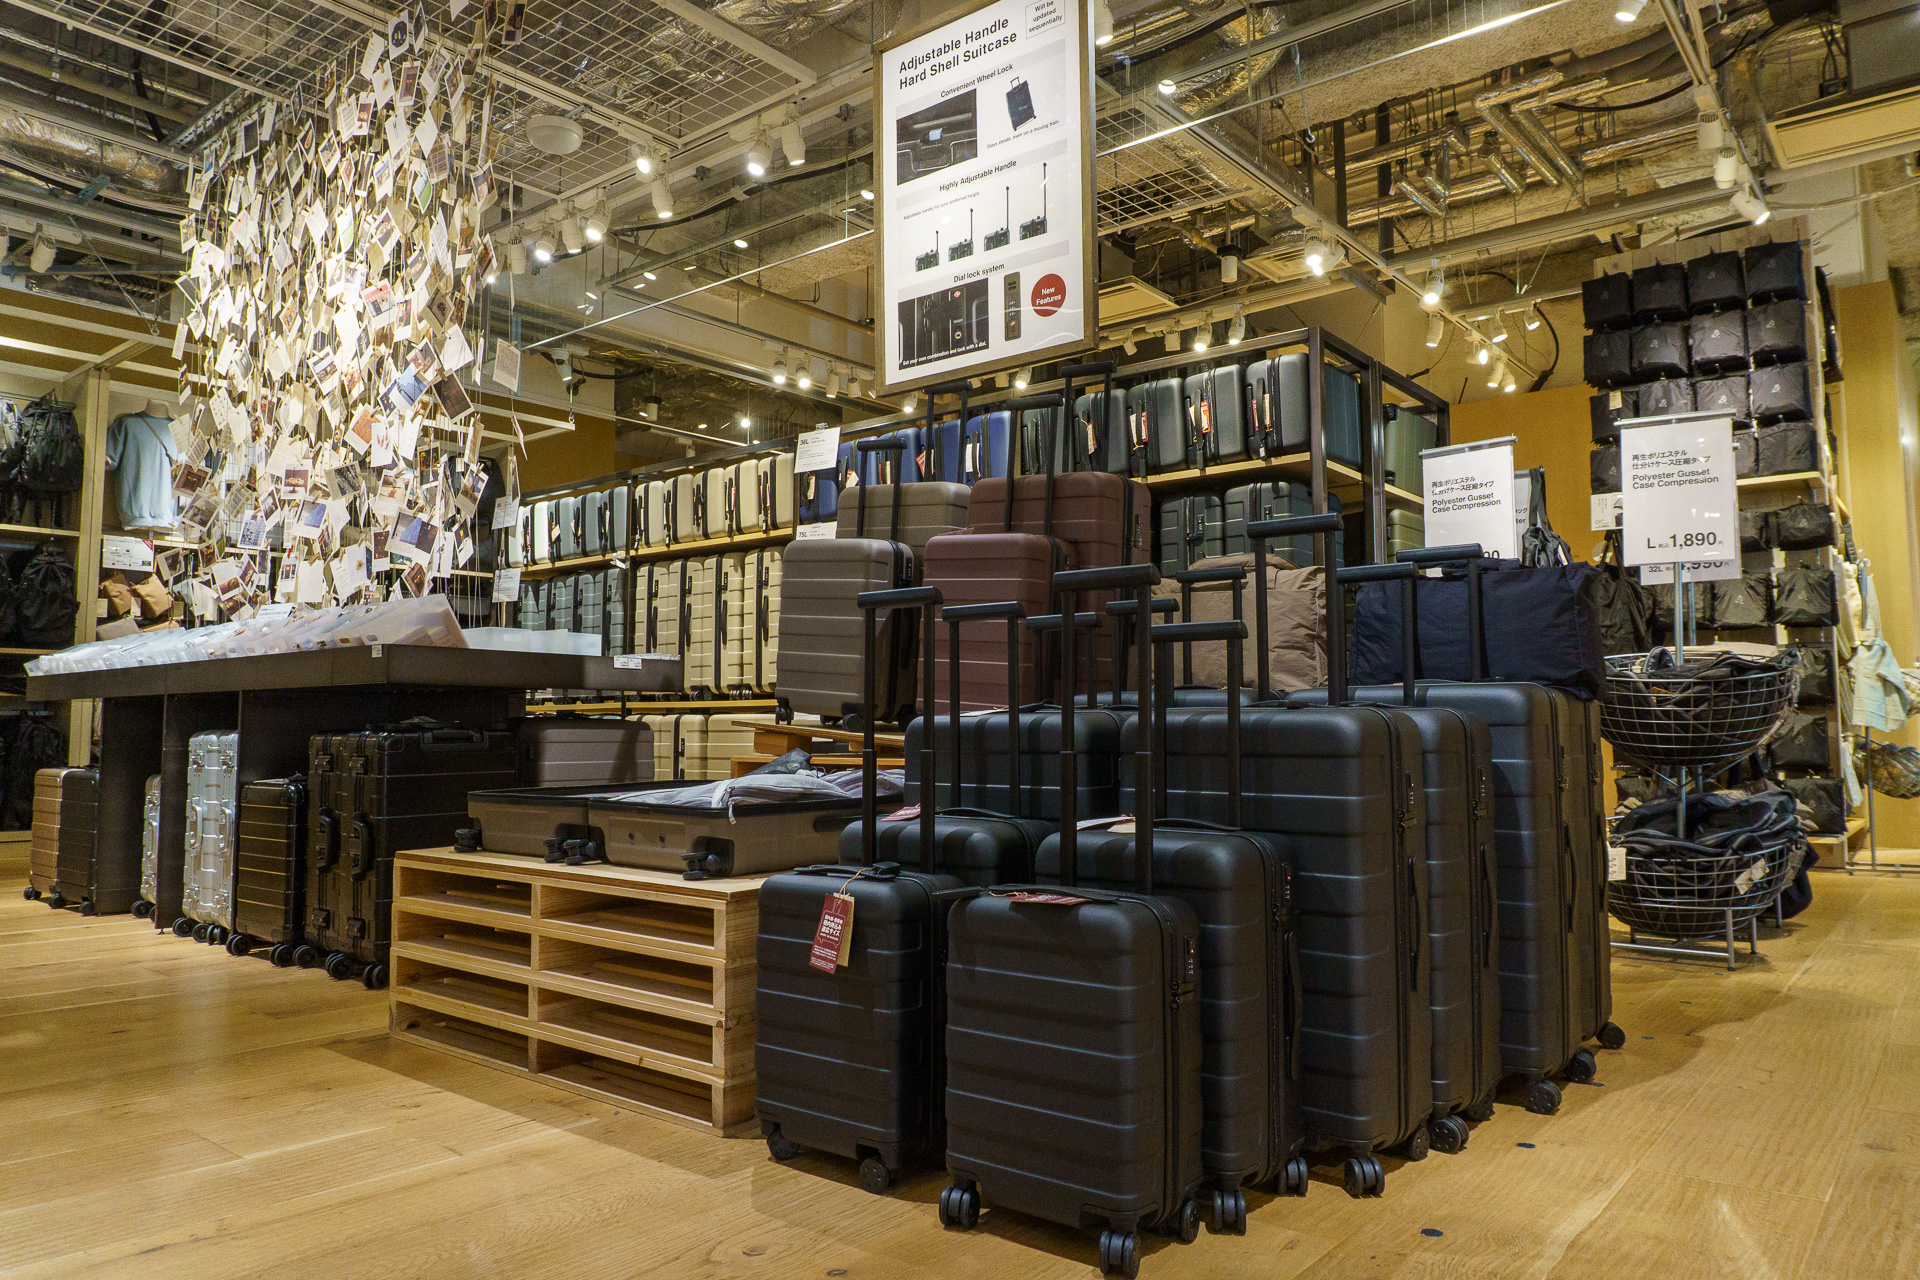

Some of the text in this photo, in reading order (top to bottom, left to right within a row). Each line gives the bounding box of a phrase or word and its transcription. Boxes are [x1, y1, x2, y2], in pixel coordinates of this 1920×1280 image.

[1034, 0, 1054, 12] Will be
[1032, 7, 1057, 22] updated
[1028, 15, 1063, 33] sequentially
[899, 17, 1009, 74] Adjustable Handle
[899, 32, 1017, 90] Hard Shell Suitcase
[940, 63, 1014, 98] Convenient Wheel Lock
[1034, 123, 1049, 133] moving
[939, 159, 1017, 193] Highly Adjustable Handle
[953, 262, 1005, 283] Dial lock system
[1041, 287, 1056, 296] New
[1036, 294, 1062, 306] Features
[926, 350, 950, 360] combination
[1632, 449, 1688, 461] 再生ポリエステル
[1432, 476, 1476, 488] 再生ポリエステル
[1632, 468, 1710, 482] Polyester Gusset
[1632, 476, 1719, 490] Case Compression
[1432, 492, 1494, 507] Polyester Gusset
[1432, 499, 1501, 514] Case Compression
[1647, 537, 1656, 549] L
[1669, 532, 1717, 550] 1,890
[1648, 565, 1664, 573] 32L
